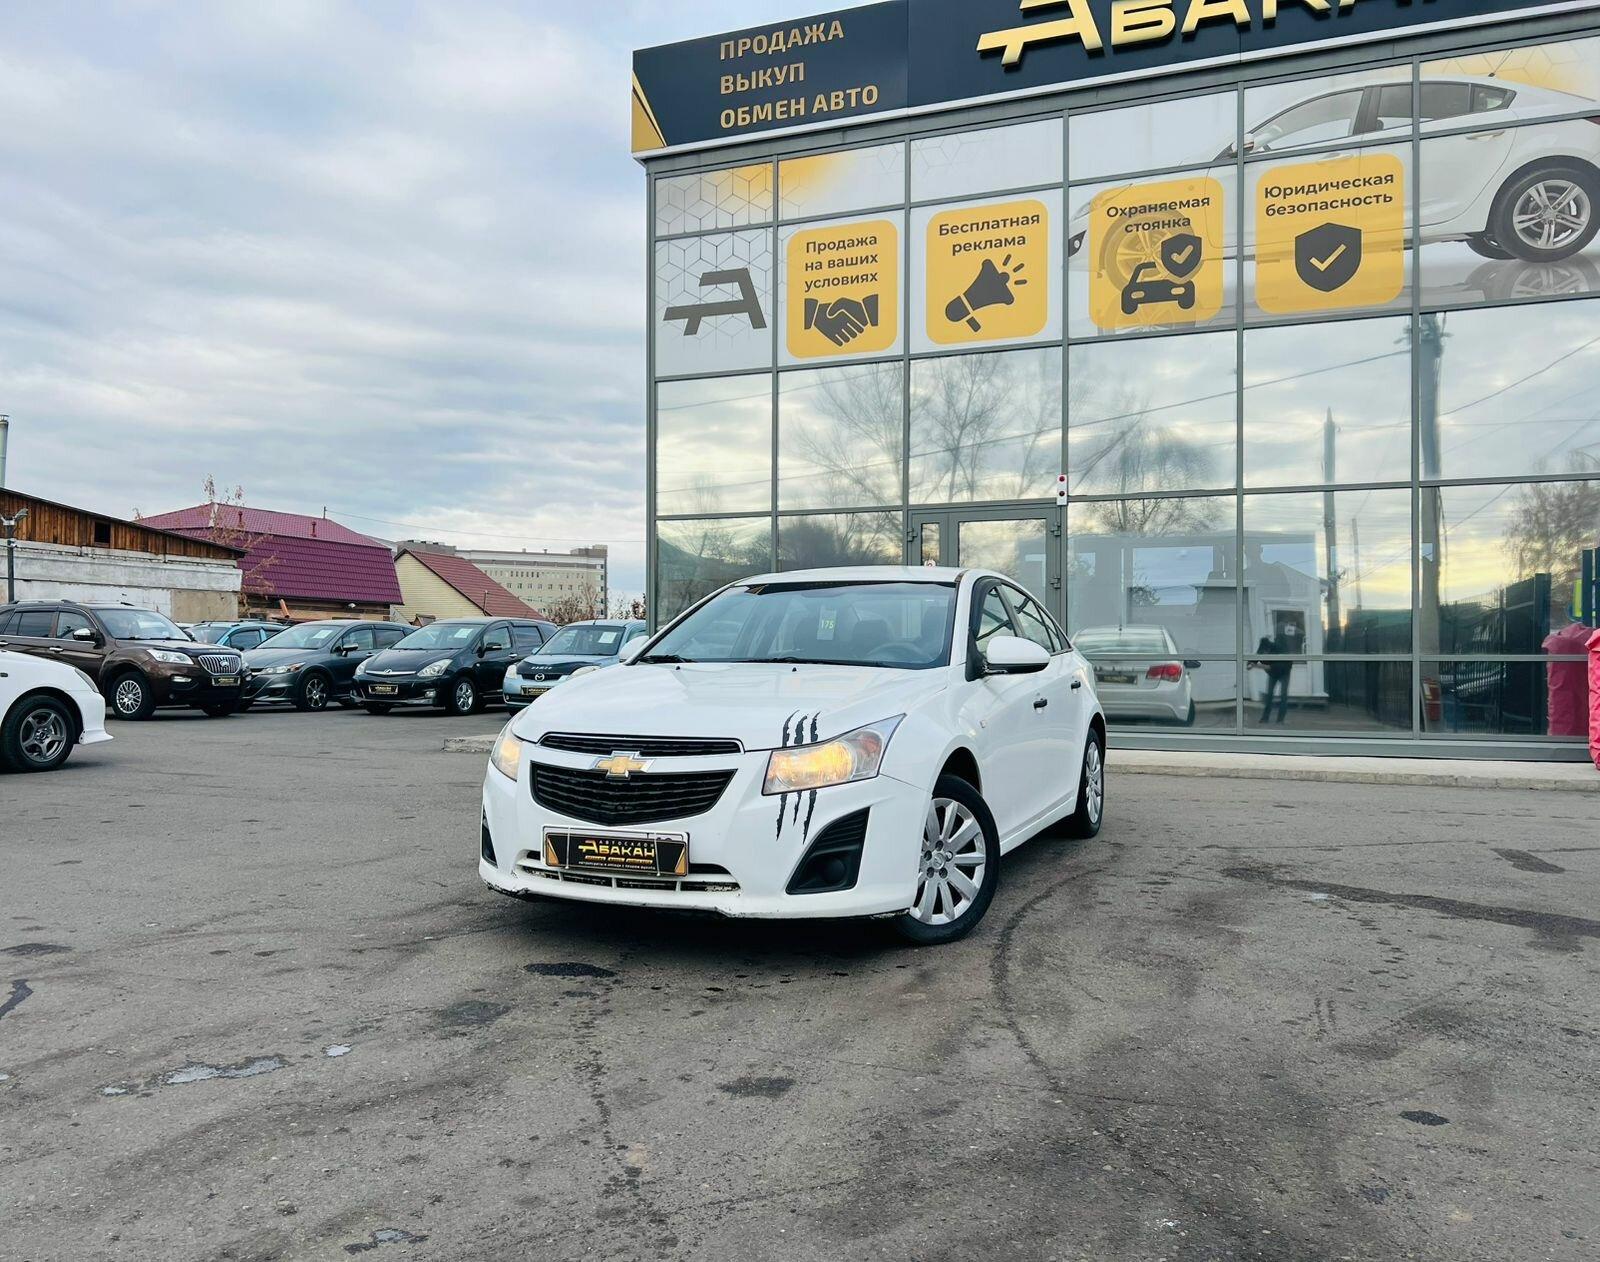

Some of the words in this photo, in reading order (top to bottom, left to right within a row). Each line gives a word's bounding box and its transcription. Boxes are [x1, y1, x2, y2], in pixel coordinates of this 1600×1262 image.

[720, 20, 844, 60] ПРОДАЖА
[720, 62, 805, 95] ВЫКУП
[720, 97, 805, 129] ОБМЕН
[812, 85, 879, 114] АВТО
[1264, 174, 1394, 199] Юридическая
[1106, 197, 1210, 218] Охраняемая
[1265, 193, 1394, 217] безопасность
[939, 214, 1040, 236] Бесплатная
[1124, 217, 1191, 233] стоянка
[806, 235, 877, 255] Продажа
[952, 235, 1026, 256] реклама
[805, 260, 823, 271] на
[828, 254, 878, 269] ваших
[804, 272, 878, 293] условиях
[578, 840, 655, 857] АБАКАН
